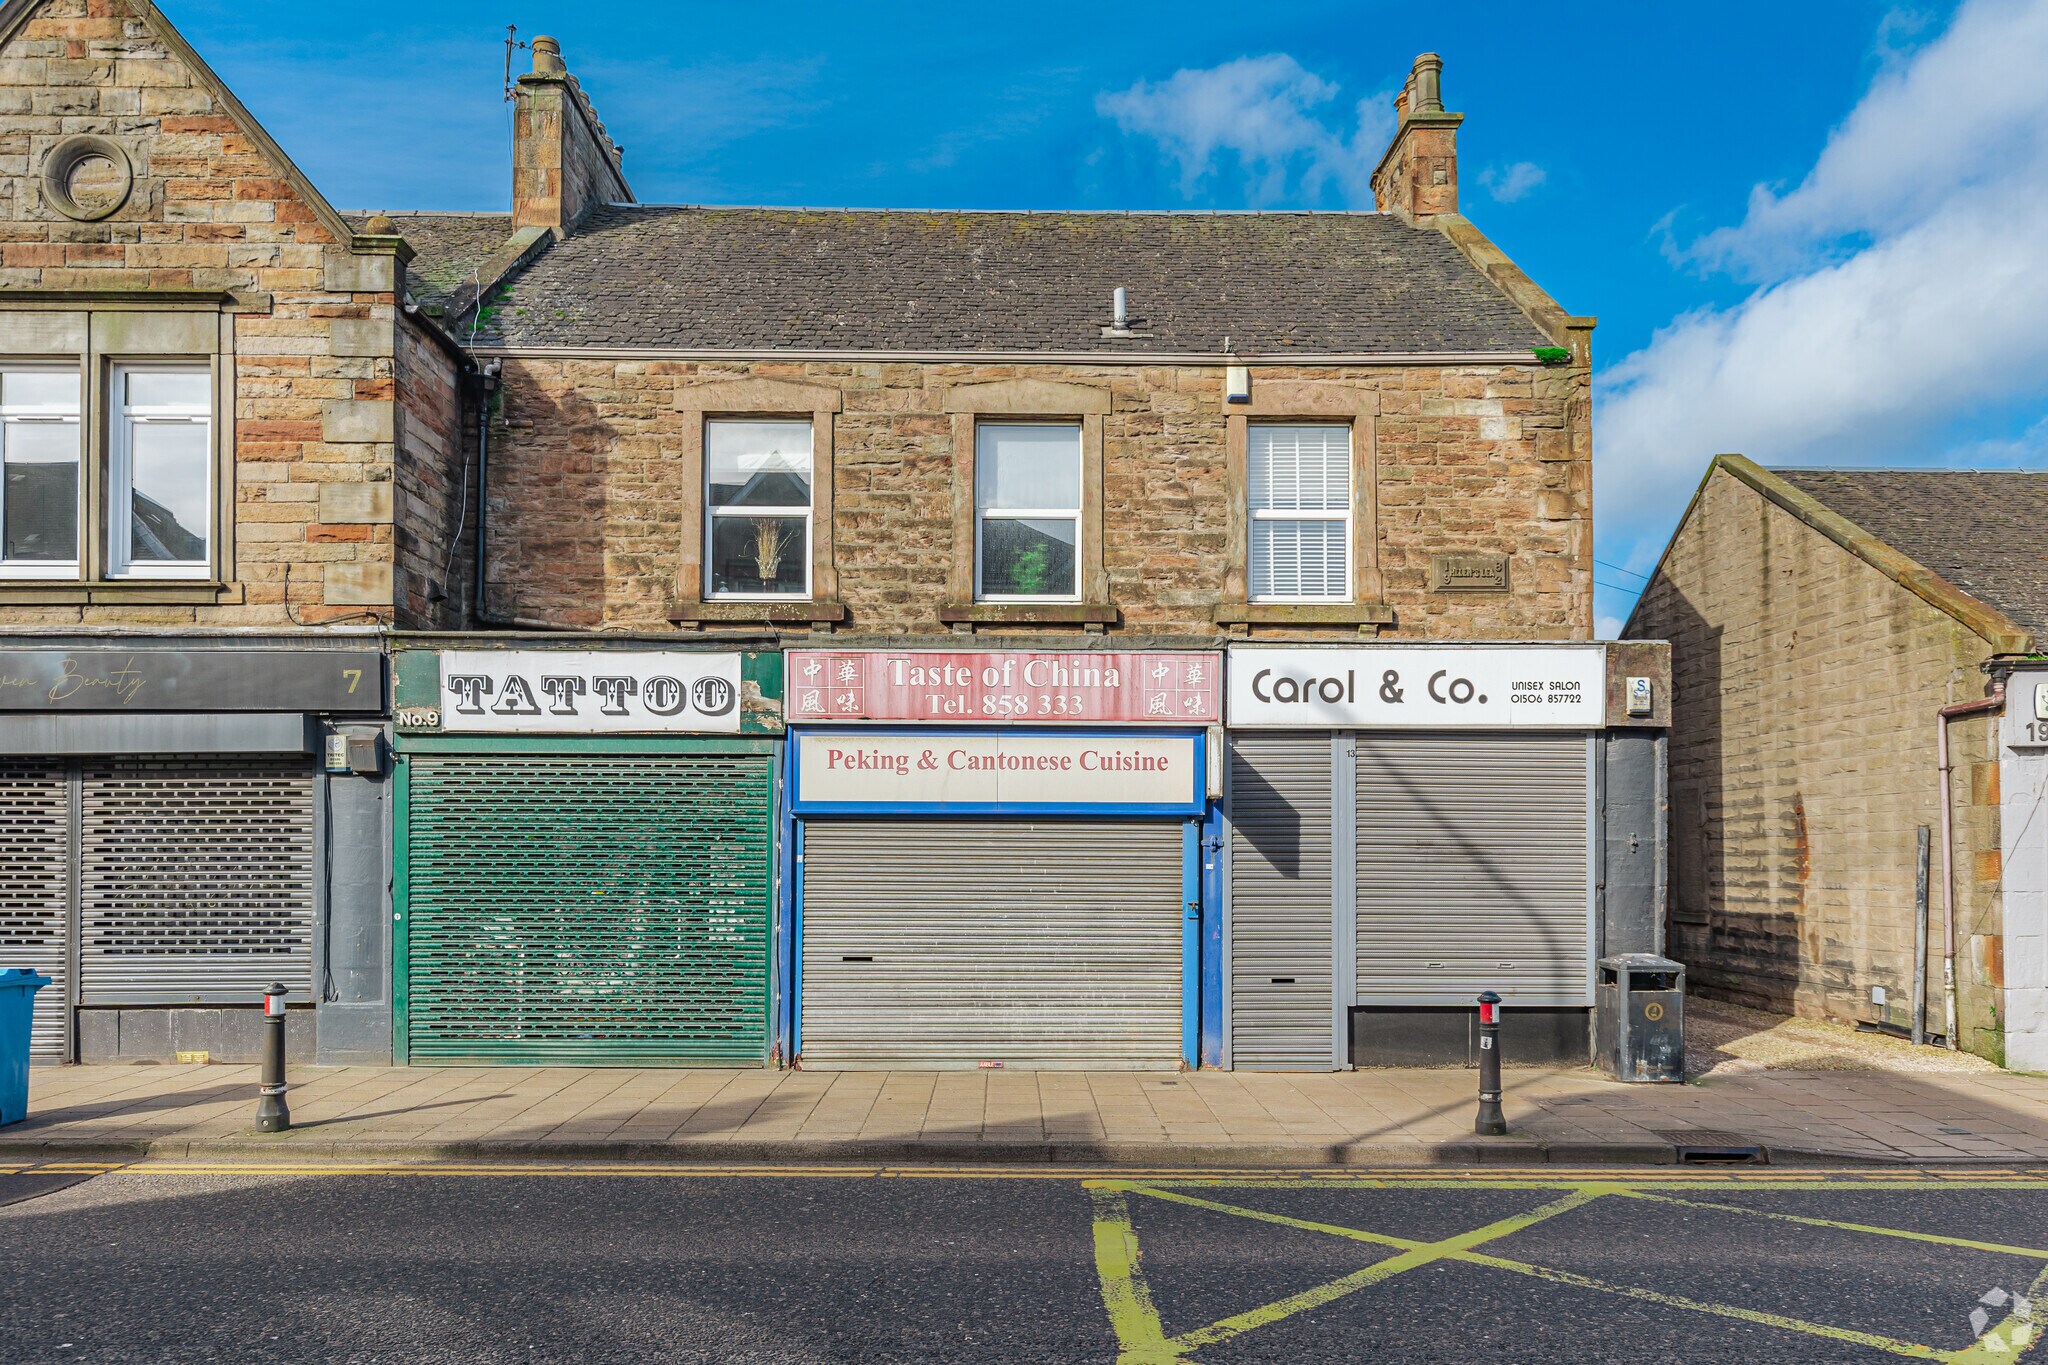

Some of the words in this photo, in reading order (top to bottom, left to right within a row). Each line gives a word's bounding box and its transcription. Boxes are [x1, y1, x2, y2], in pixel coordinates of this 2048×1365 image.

[49, 656, 146, 704] Beauty
[342, 669, 362, 694] 7
[887, 659, 972, 688] Taste
[981, 659, 1015, 688] of
[1023, 659, 1120, 689] China
[1252, 668, 1354, 704] Carol
[1379, 669, 1405, 704] &
[1427, 669, 1489, 704] Co.
[1511, 681, 1544, 691] UNISEX
[1549, 681, 1581, 691] SALON
[448, 674, 736, 716] TATTOO
[925, 694, 973, 715] Tel.
[982, 694, 1029, 715] 858
[1037, 695, 1083, 716] 333
[1510, 694, 1543, 703] 01506
[1547, 694, 1581, 703] 857722
[827, 749, 910, 776] Peking
[917, 749, 939, 771] &
[947, 749, 1073, 771] Cantonese
[1079, 750, 1169, 772] Cuisine
[1346, 749, 1356, 758] 13
